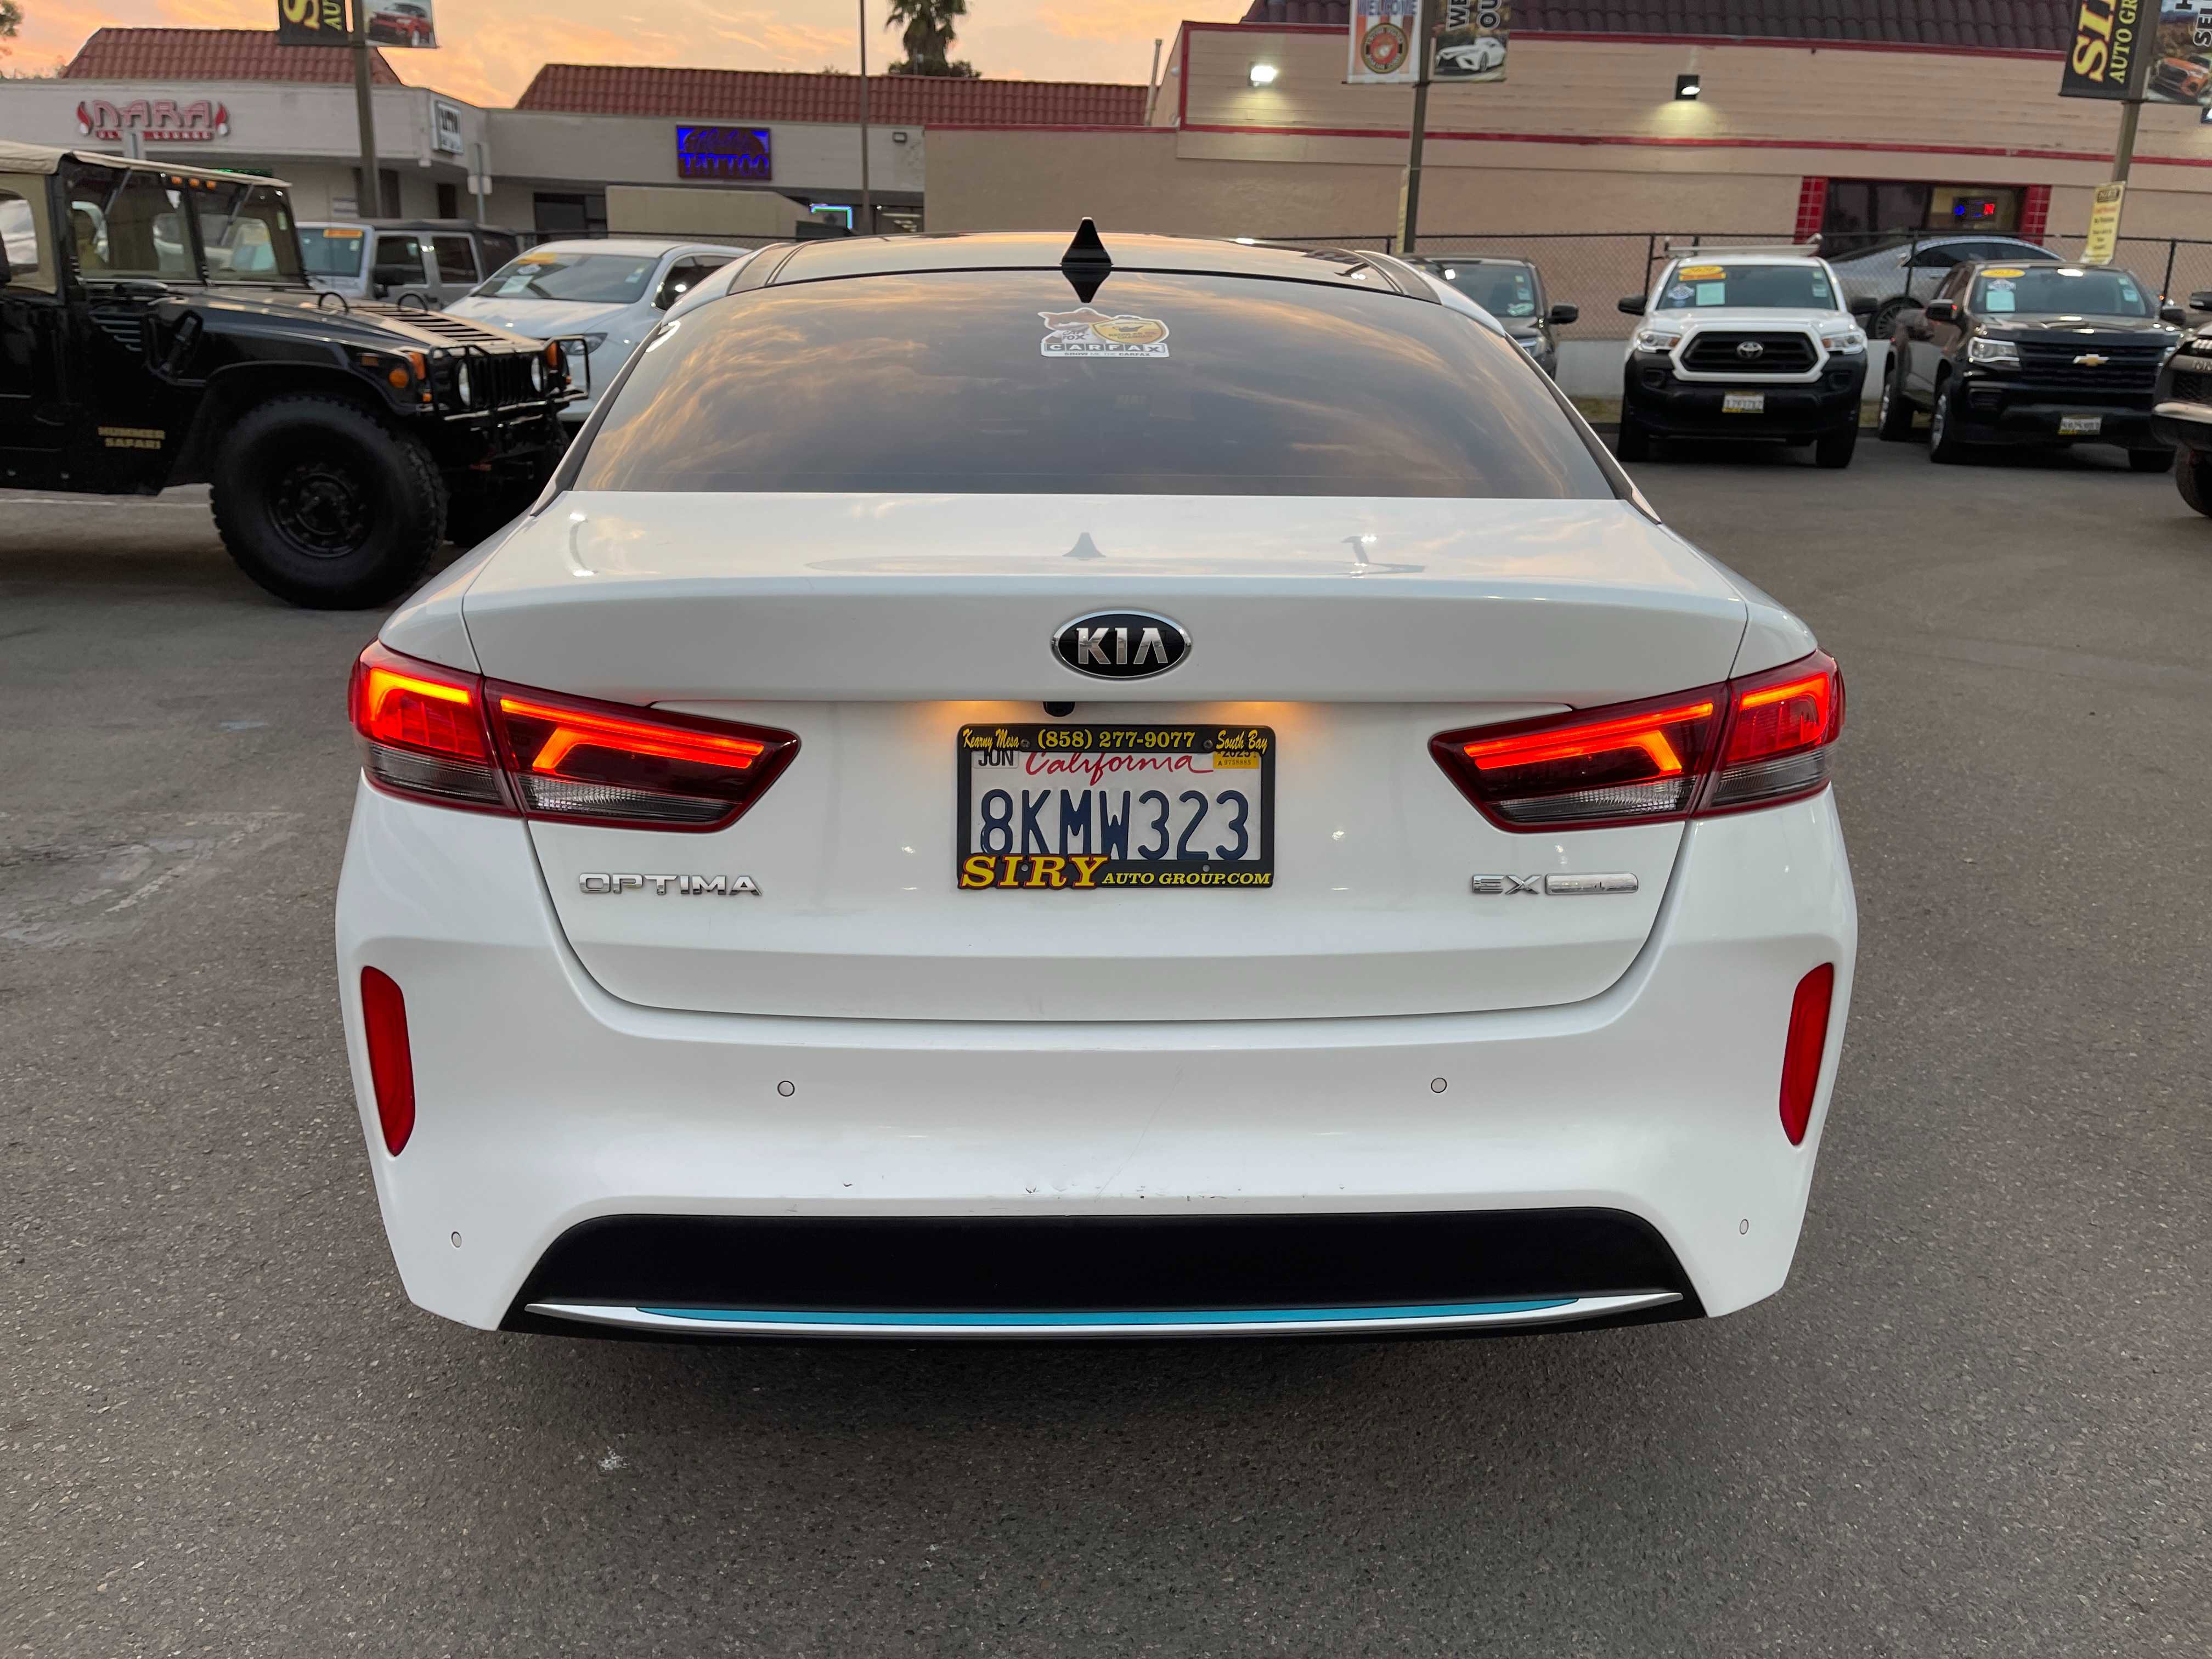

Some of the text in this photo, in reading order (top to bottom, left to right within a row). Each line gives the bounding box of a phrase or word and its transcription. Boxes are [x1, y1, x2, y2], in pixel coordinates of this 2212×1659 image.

[1357, 0, 1417, 15] WELCOME
[2108, 29, 2132, 84] AUTO
[679, 153, 770, 176] TATTOO
[1049, 344, 1160, 352] CARFAX
[1076, 627, 1168, 664] KIA
[962, 729, 1019, 752] Kearny Mesa
[1037, 729, 1195, 749] (858) 277-9077
[1216, 729, 1268, 754] South Bay
[1025, 753, 1214, 786] California
[980, 789, 1249, 860] 8KMW323
[962, 854, 1271, 889] SIRY AUTO GROUP.COM
[579, 872, 763, 896] OPTIMA
[1472, 873, 1541, 895] EX
